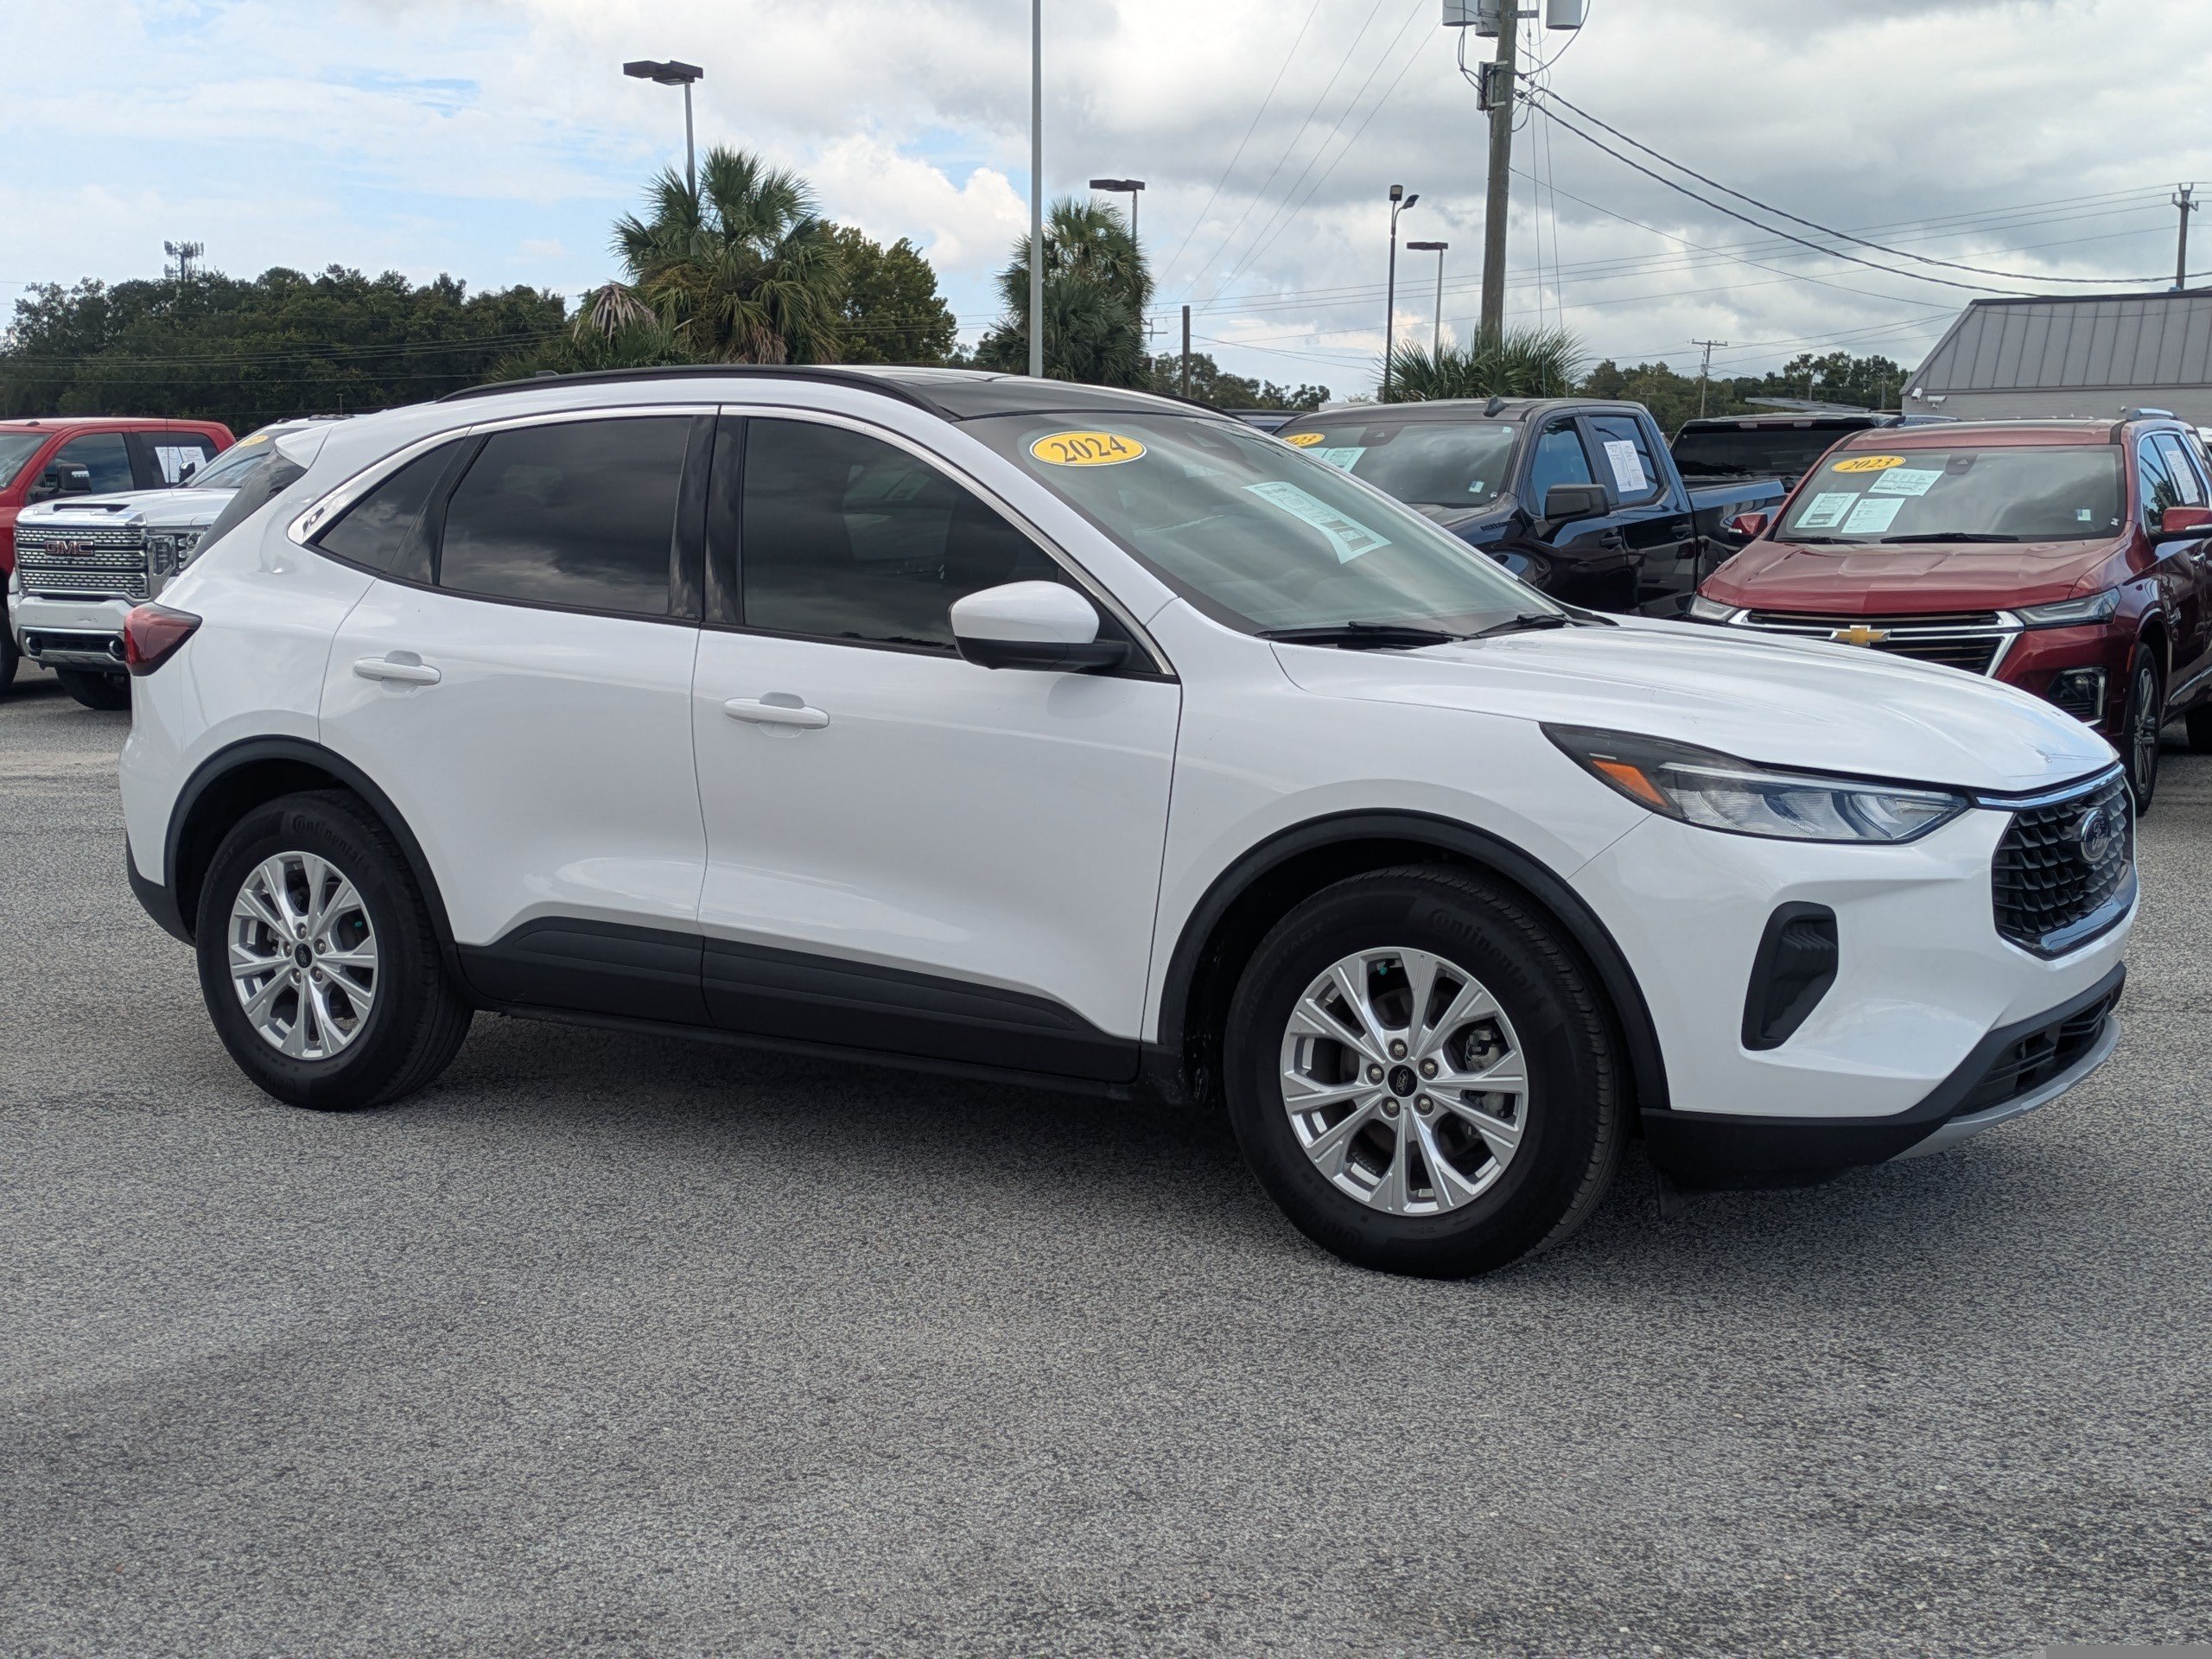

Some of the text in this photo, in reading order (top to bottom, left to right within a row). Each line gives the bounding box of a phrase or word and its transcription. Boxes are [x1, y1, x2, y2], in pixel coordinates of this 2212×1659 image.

[1051, 435, 1128, 462] 2024
[1842, 458, 1895, 471] 2023
[44, 540, 93, 555] GMC
[1427, 907, 1535, 994] Continental
